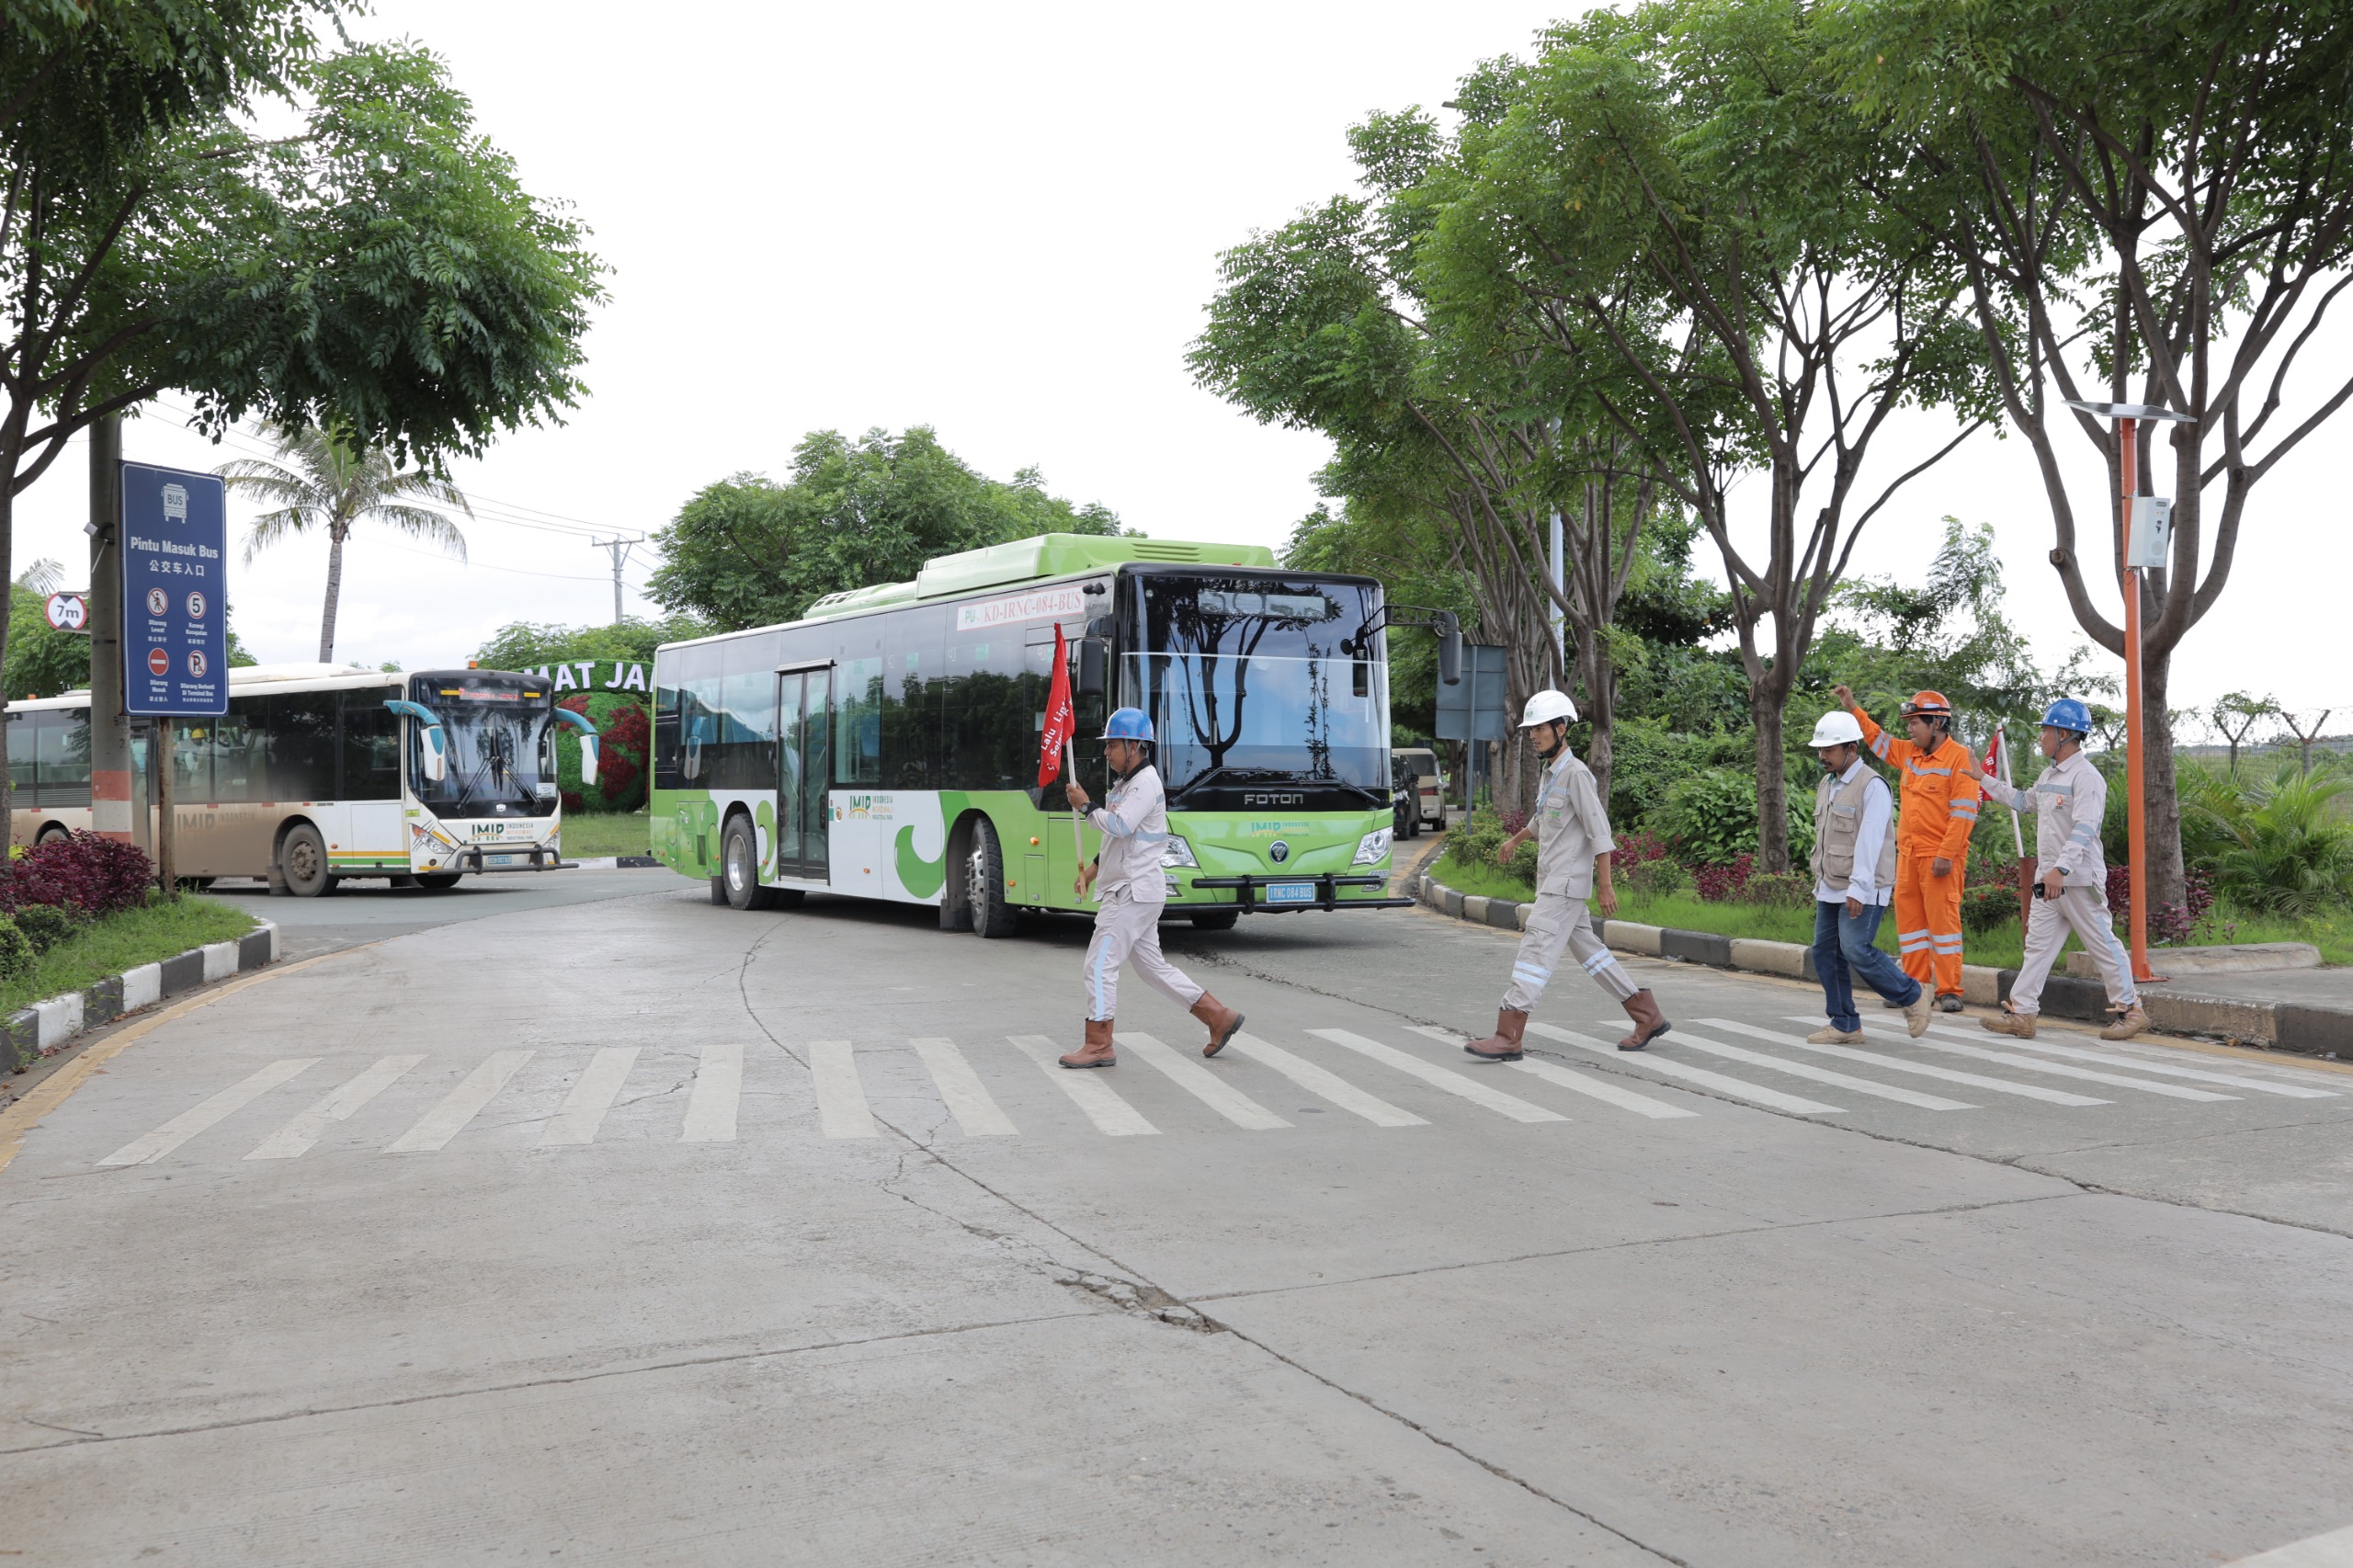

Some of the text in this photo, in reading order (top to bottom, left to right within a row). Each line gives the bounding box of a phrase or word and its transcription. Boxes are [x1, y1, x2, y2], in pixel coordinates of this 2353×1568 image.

[167, 494, 183, 506] BUS
[131, 536, 219, 559] Pintu Masuk Bus
[149, 559, 205, 577] 公交车入口
[57, 605, 80, 619] 7m
[192, 597, 200, 614] 5
[984, 591, 1081, 622] KD-IRNC-084-BUS
[605, 662, 655, 692] JA
[1040, 728, 1057, 751] Lalu
[848, 795, 871, 819] IMIP
[1244, 793, 1304, 804] FOTON
[218, 812, 256, 823] INDONESIA
[472, 824, 505, 841] IMIP
[1287, 887, 1299, 898] 084
[1300, 886, 1313, 898] BUS
